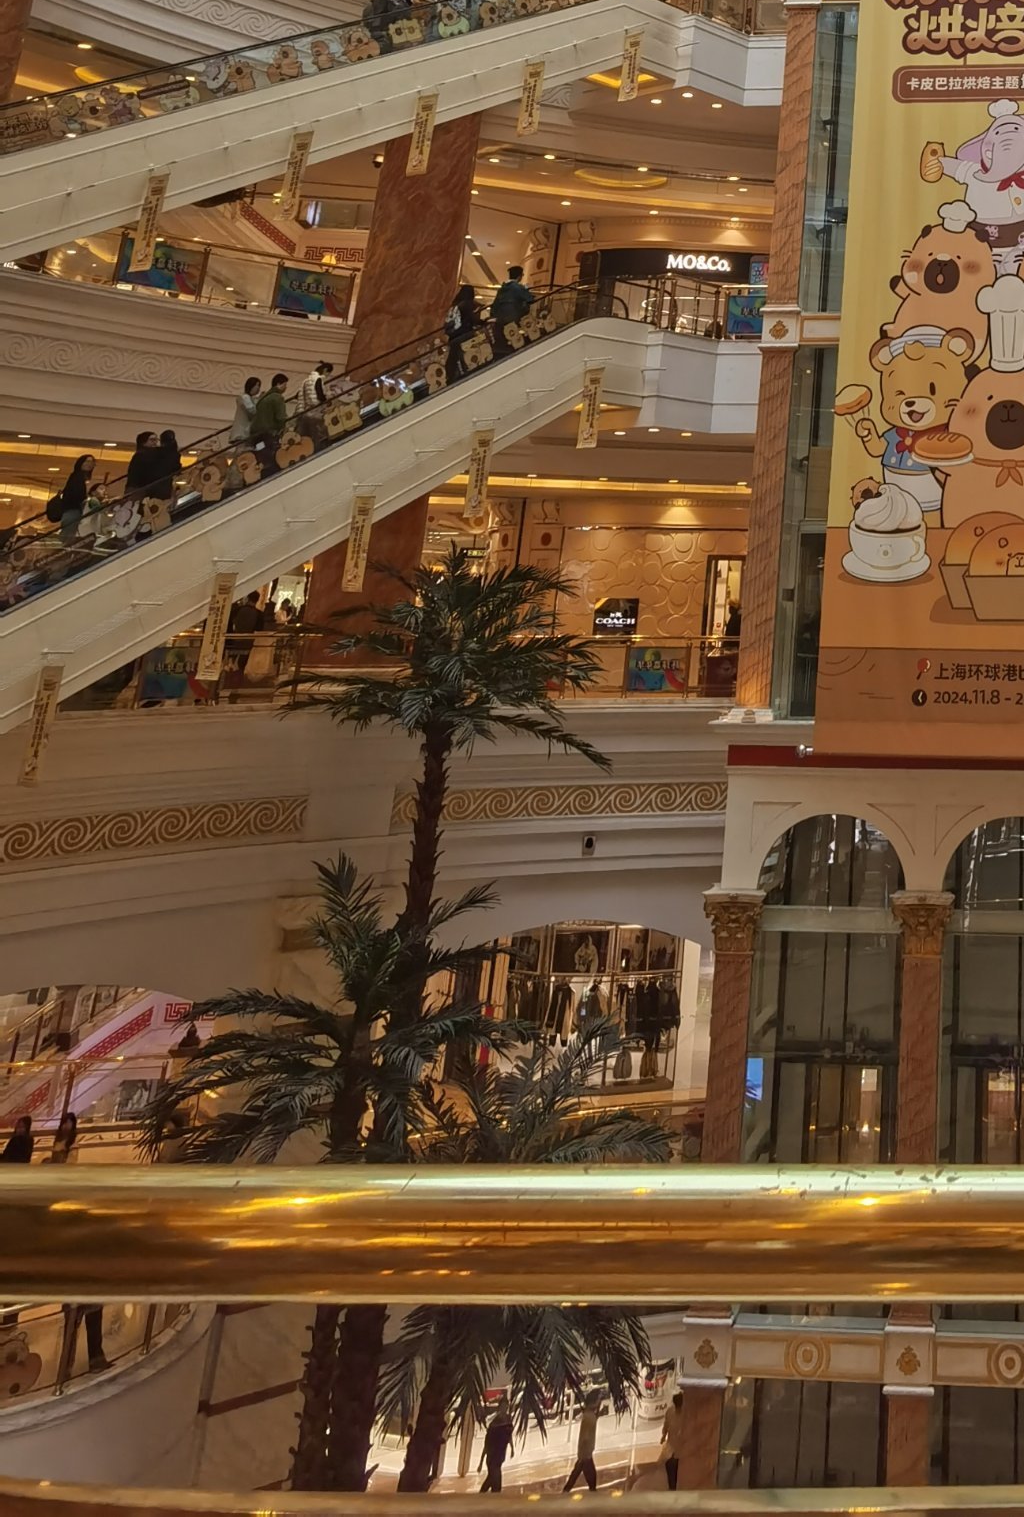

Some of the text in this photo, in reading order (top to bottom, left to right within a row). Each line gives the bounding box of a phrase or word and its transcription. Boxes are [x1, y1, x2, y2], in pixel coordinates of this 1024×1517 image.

[666, 254, 731, 272] MO&Co.
[595, 617, 636, 625] COACH
[933, 689, 1000, 705] 2024.11.8
